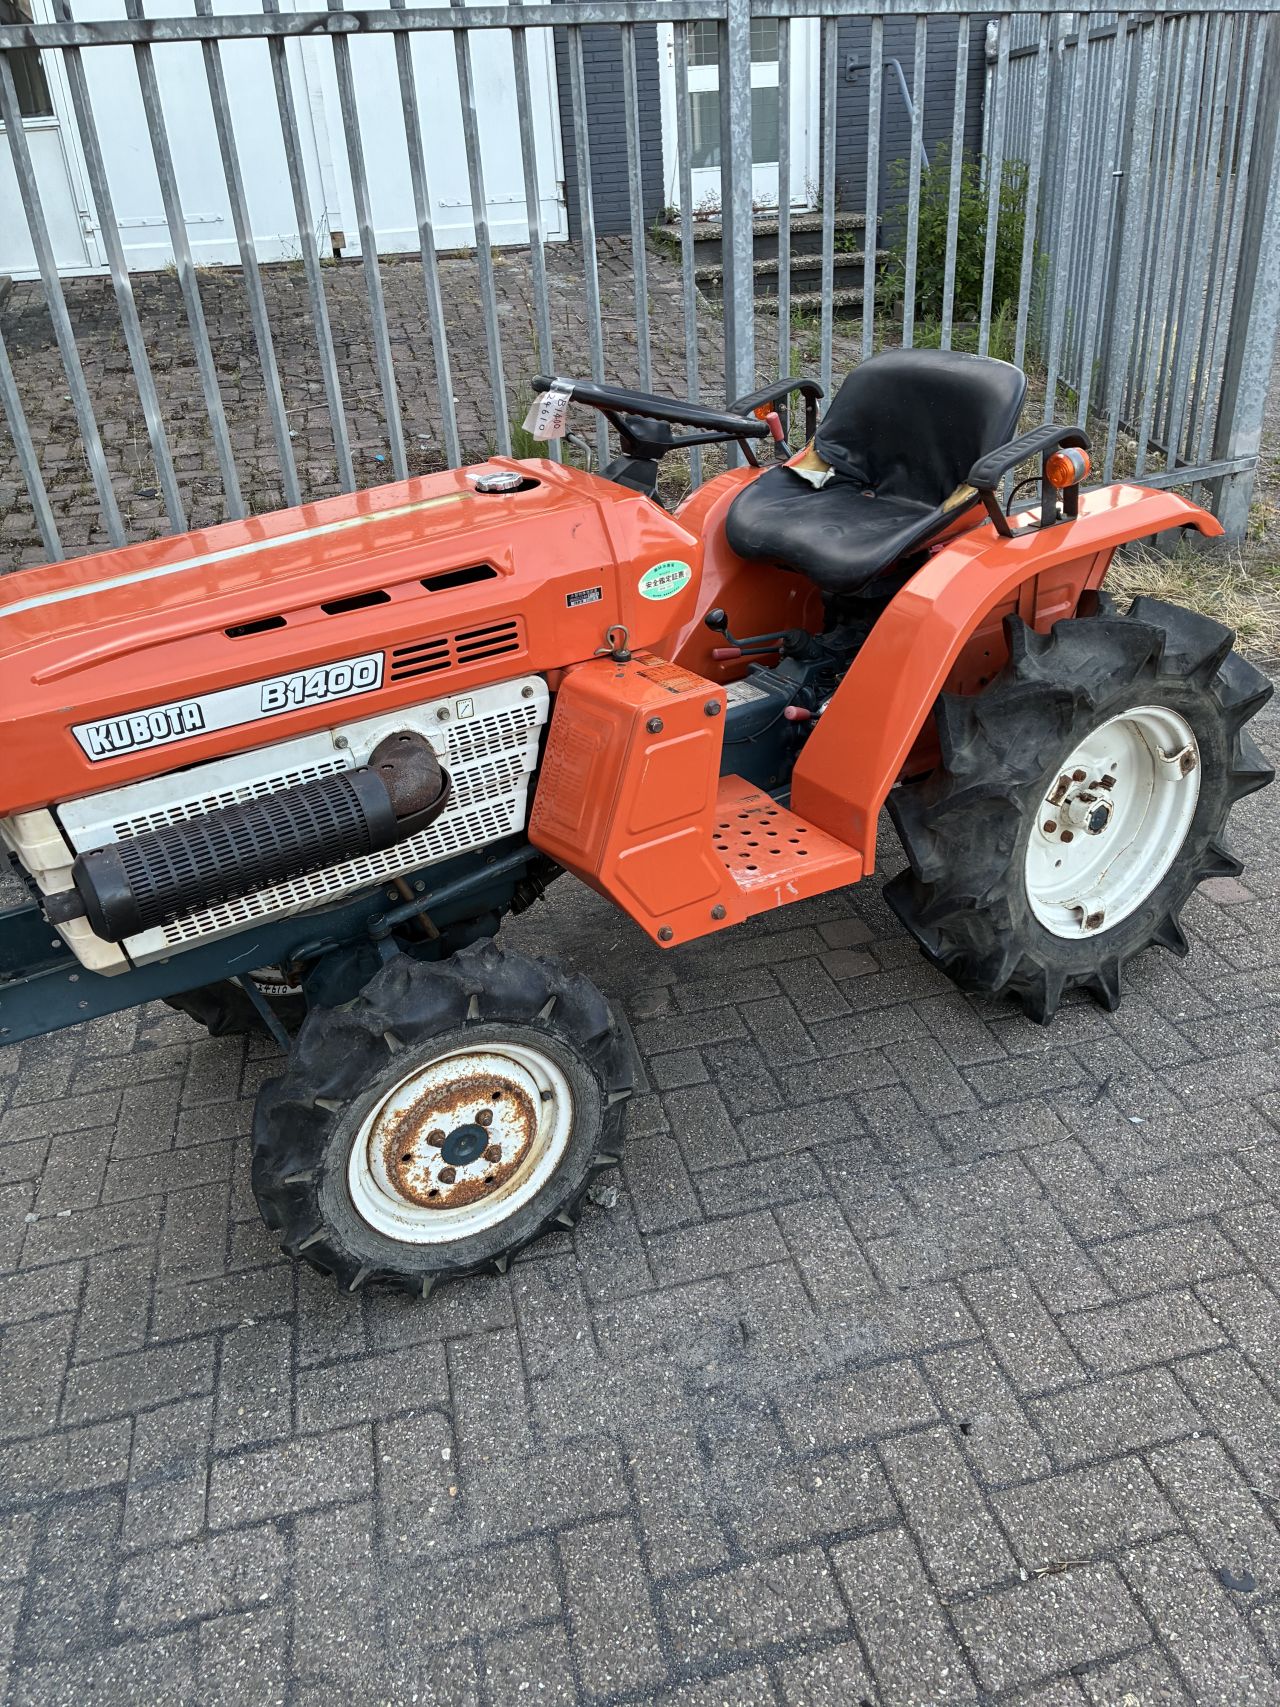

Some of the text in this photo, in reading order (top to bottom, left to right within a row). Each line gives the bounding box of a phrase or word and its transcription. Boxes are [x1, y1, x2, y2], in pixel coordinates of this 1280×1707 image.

[538, 394, 555, 431] 24610
[553, 398, 566, 430] B1400
[87, 659, 380, 754] KUBOTA B1400
